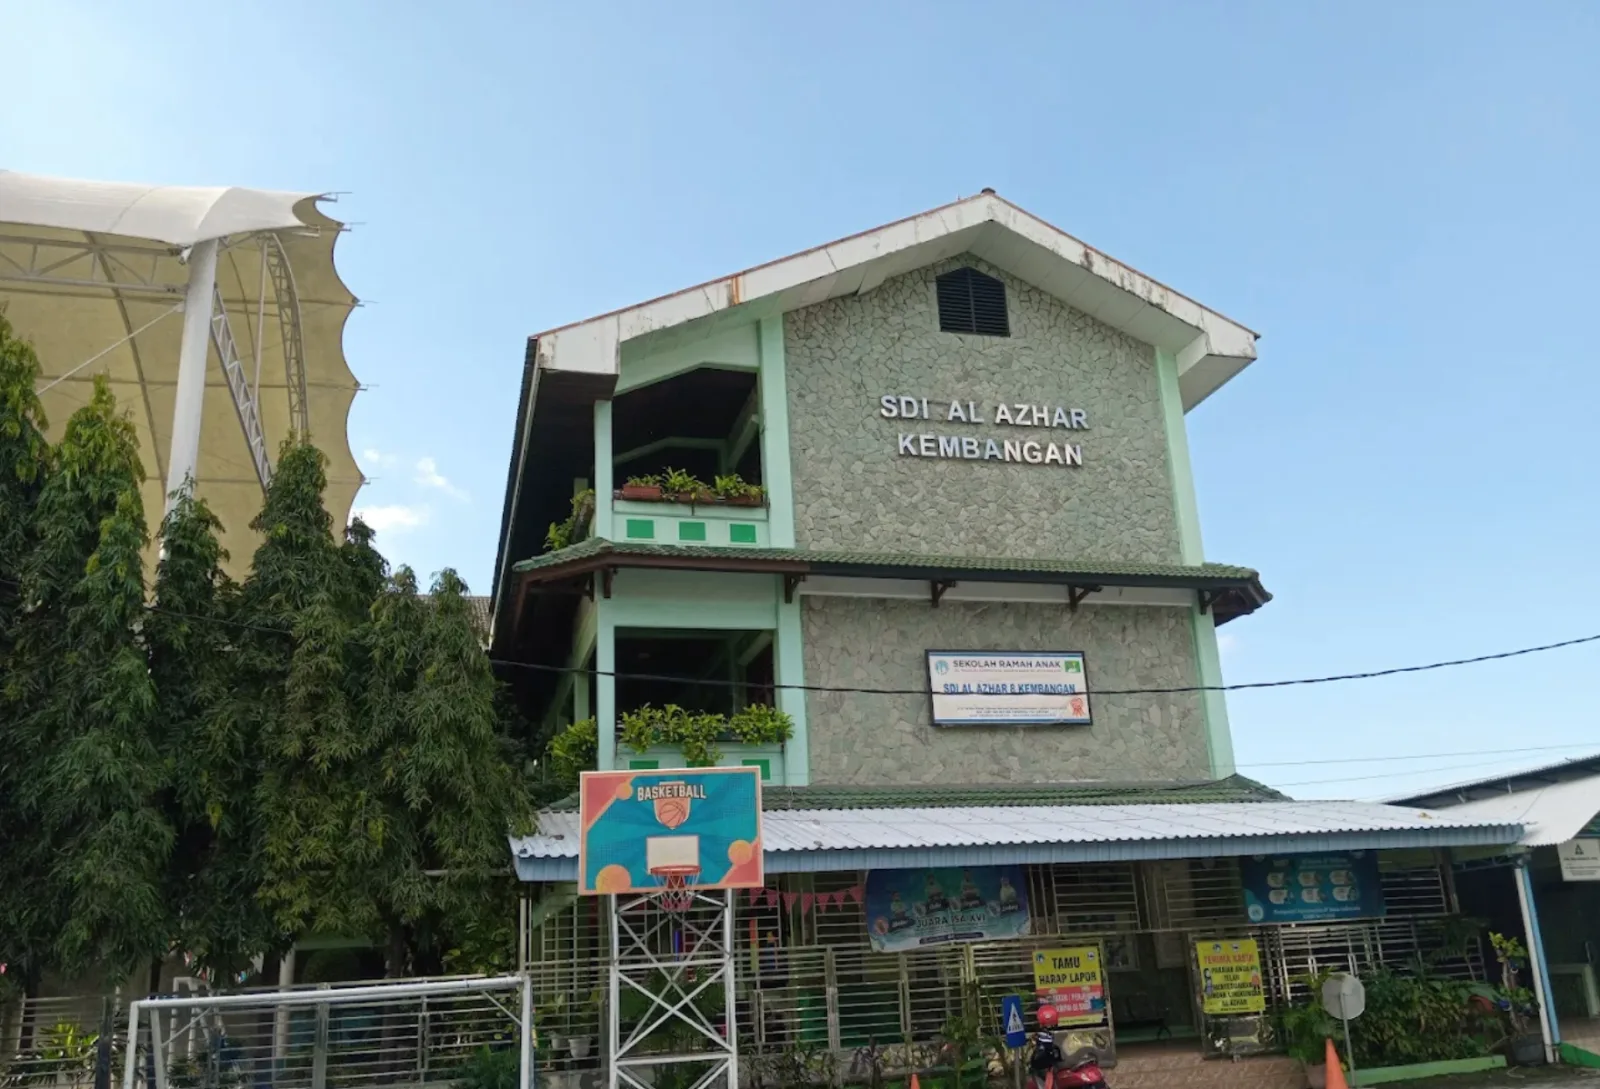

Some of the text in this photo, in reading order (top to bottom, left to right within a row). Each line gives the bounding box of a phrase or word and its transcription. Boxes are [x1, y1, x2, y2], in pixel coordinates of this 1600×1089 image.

[880, 395, 1090, 430] SDI AL AZHAR
[897, 432, 1083, 467] KEMBANGAN
[952, 660, 1061, 668] SEKOLAH RAMAH ANAK
[943, 683, 959, 693] SDI
[962, 683, 973, 693] AL
[976, 683, 1008, 693] AZHAR
[1018, 683, 1076, 693] KEMBANGAN
[637, 784, 707, 801] BASKETBALL
[917, 916, 949, 928] JUARA
[1052, 957, 1080, 969] TAMU
[1039, 971, 1097, 984] HARAP LAPOR
